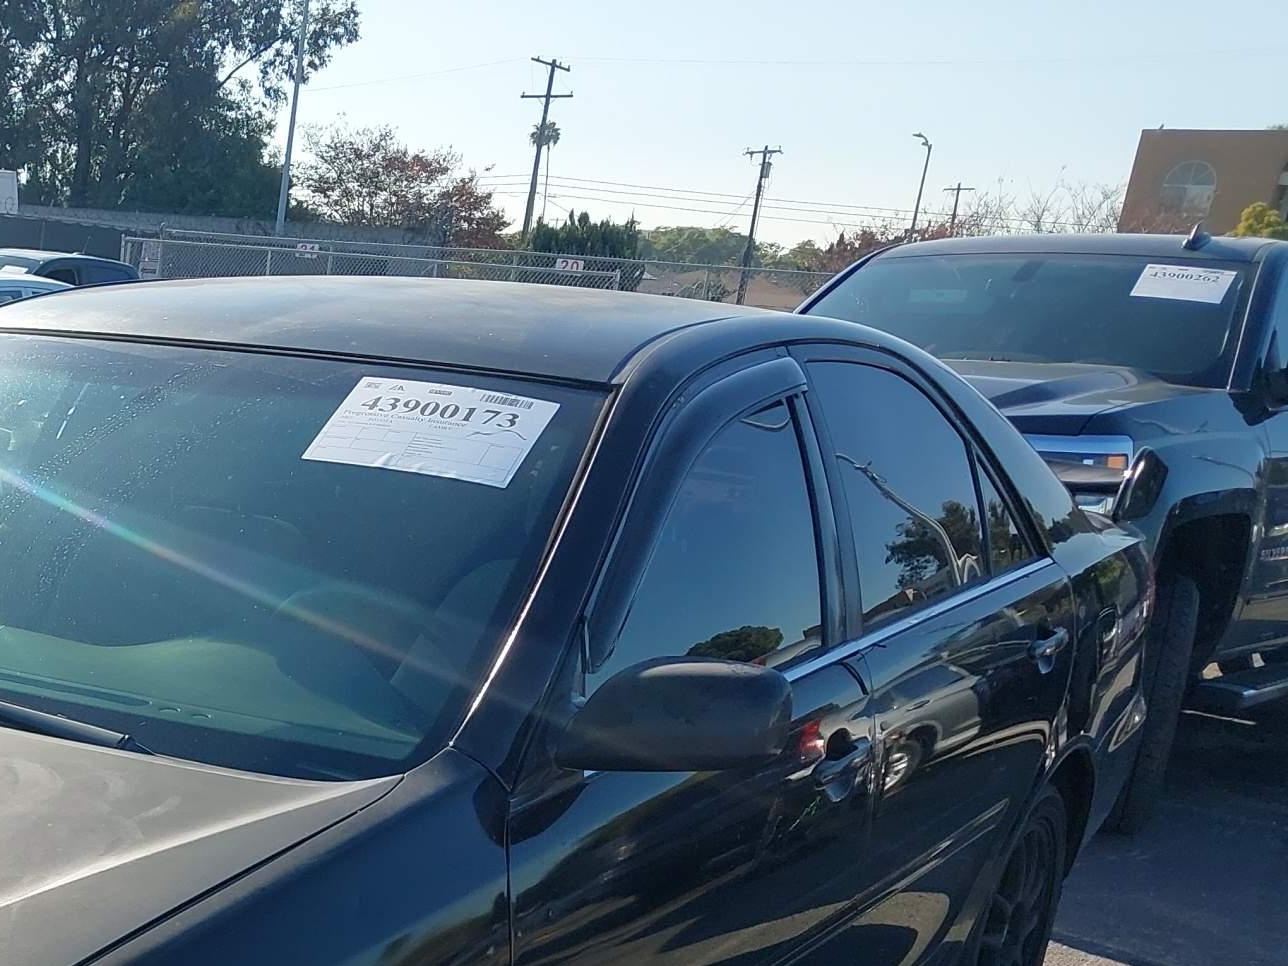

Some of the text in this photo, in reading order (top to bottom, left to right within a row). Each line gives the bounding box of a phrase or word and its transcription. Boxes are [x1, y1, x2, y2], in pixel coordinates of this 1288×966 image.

[560, 260, 579, 271] 20
[1149, 271, 1220, 282] 43900262
[360, 395, 521, 429] 43900173
[391, 414, 425, 423] Casualty
[427, 418, 468, 428] Insurance
